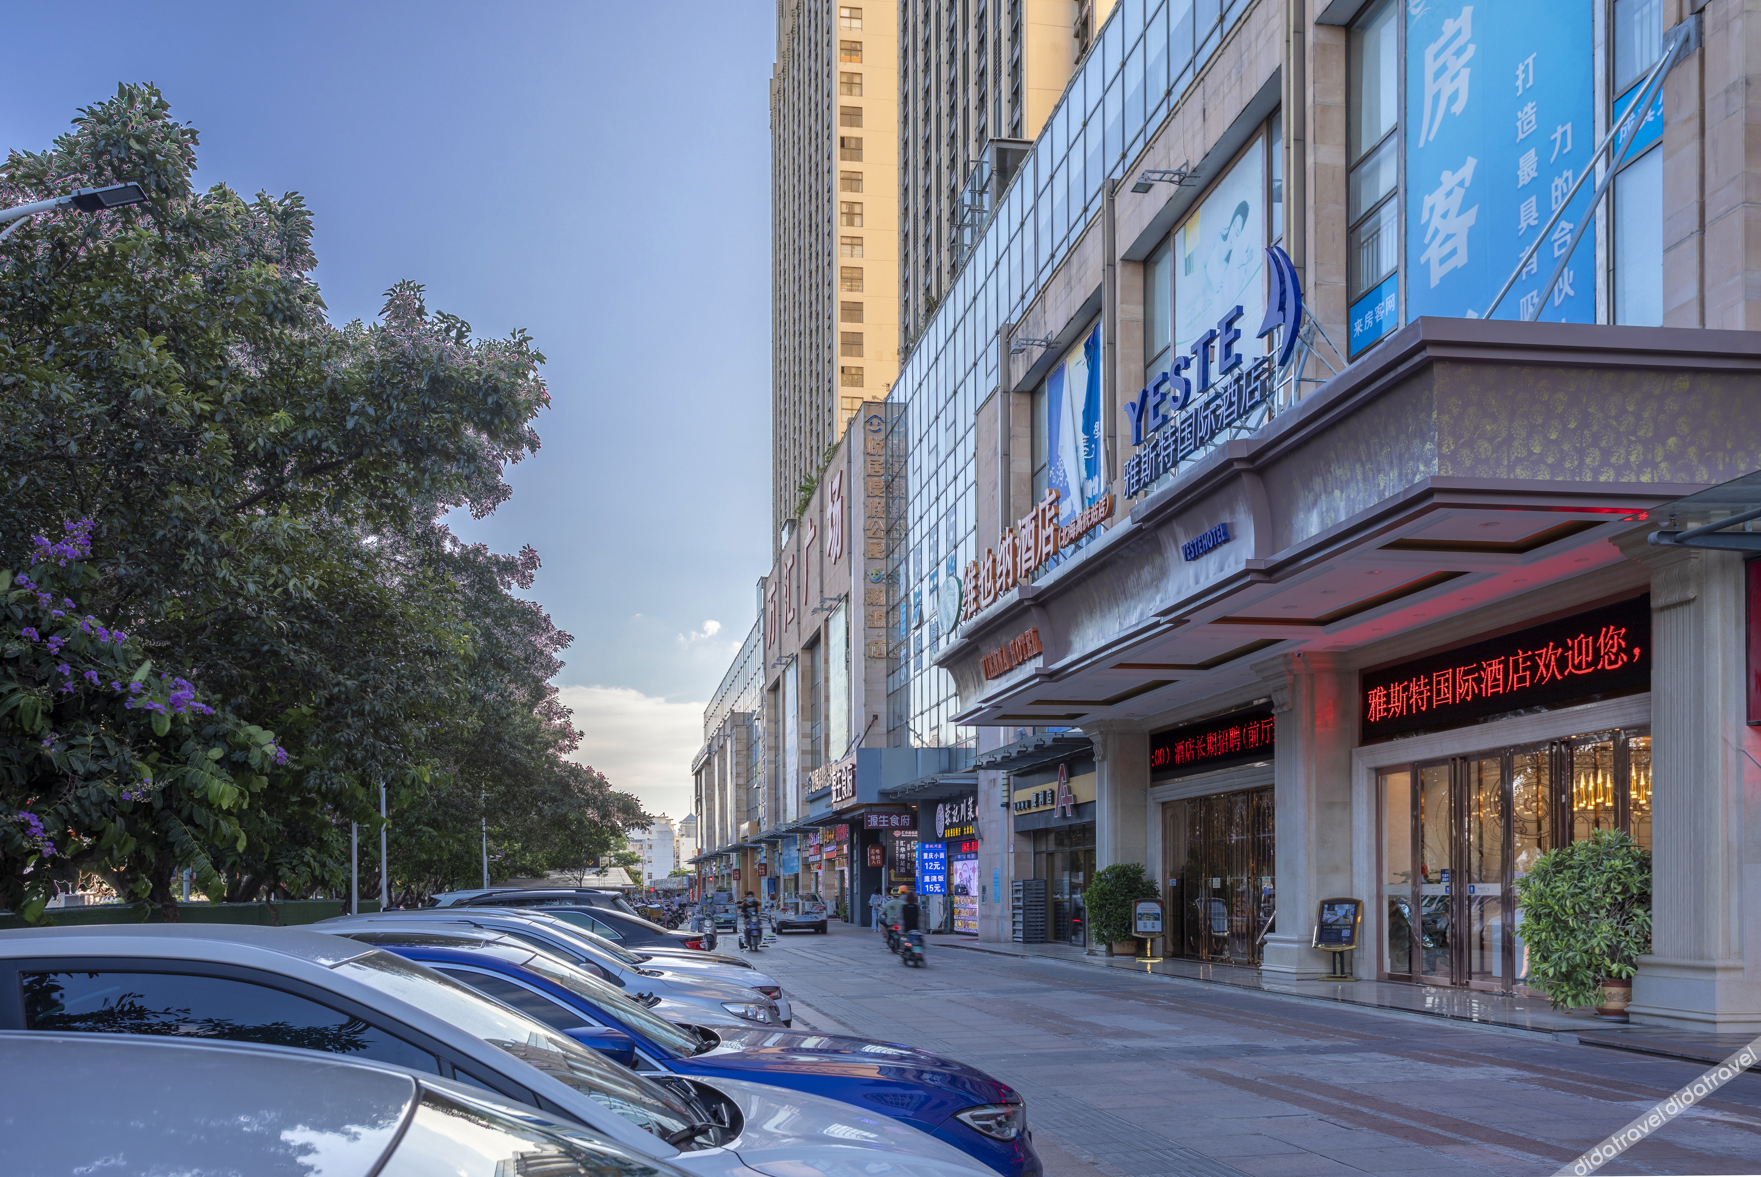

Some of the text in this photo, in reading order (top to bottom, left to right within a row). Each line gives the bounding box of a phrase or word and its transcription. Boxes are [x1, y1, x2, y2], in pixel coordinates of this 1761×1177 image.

[1418, 5, 1479, 319] 房客
[1550, 121, 1576, 323] 力的合伙
[1124, 305, 1243, 446] YESTE
[1353, 292, 1396, 338] 来房客网
[1123, 357, 1268, 500] 雅斯特国际酒店
[767, 470, 844, 650] 万汇广场
[866, 436, 886, 560] 悦居度假公寓
[962, 488, 1061, 621] 维也纳酒店
[1175, 716, 1275, 764] 酒店长期招聘(前厅
[868, 814, 911, 827] 源生食府
[923, 852, 945, 860] 重庆小面
